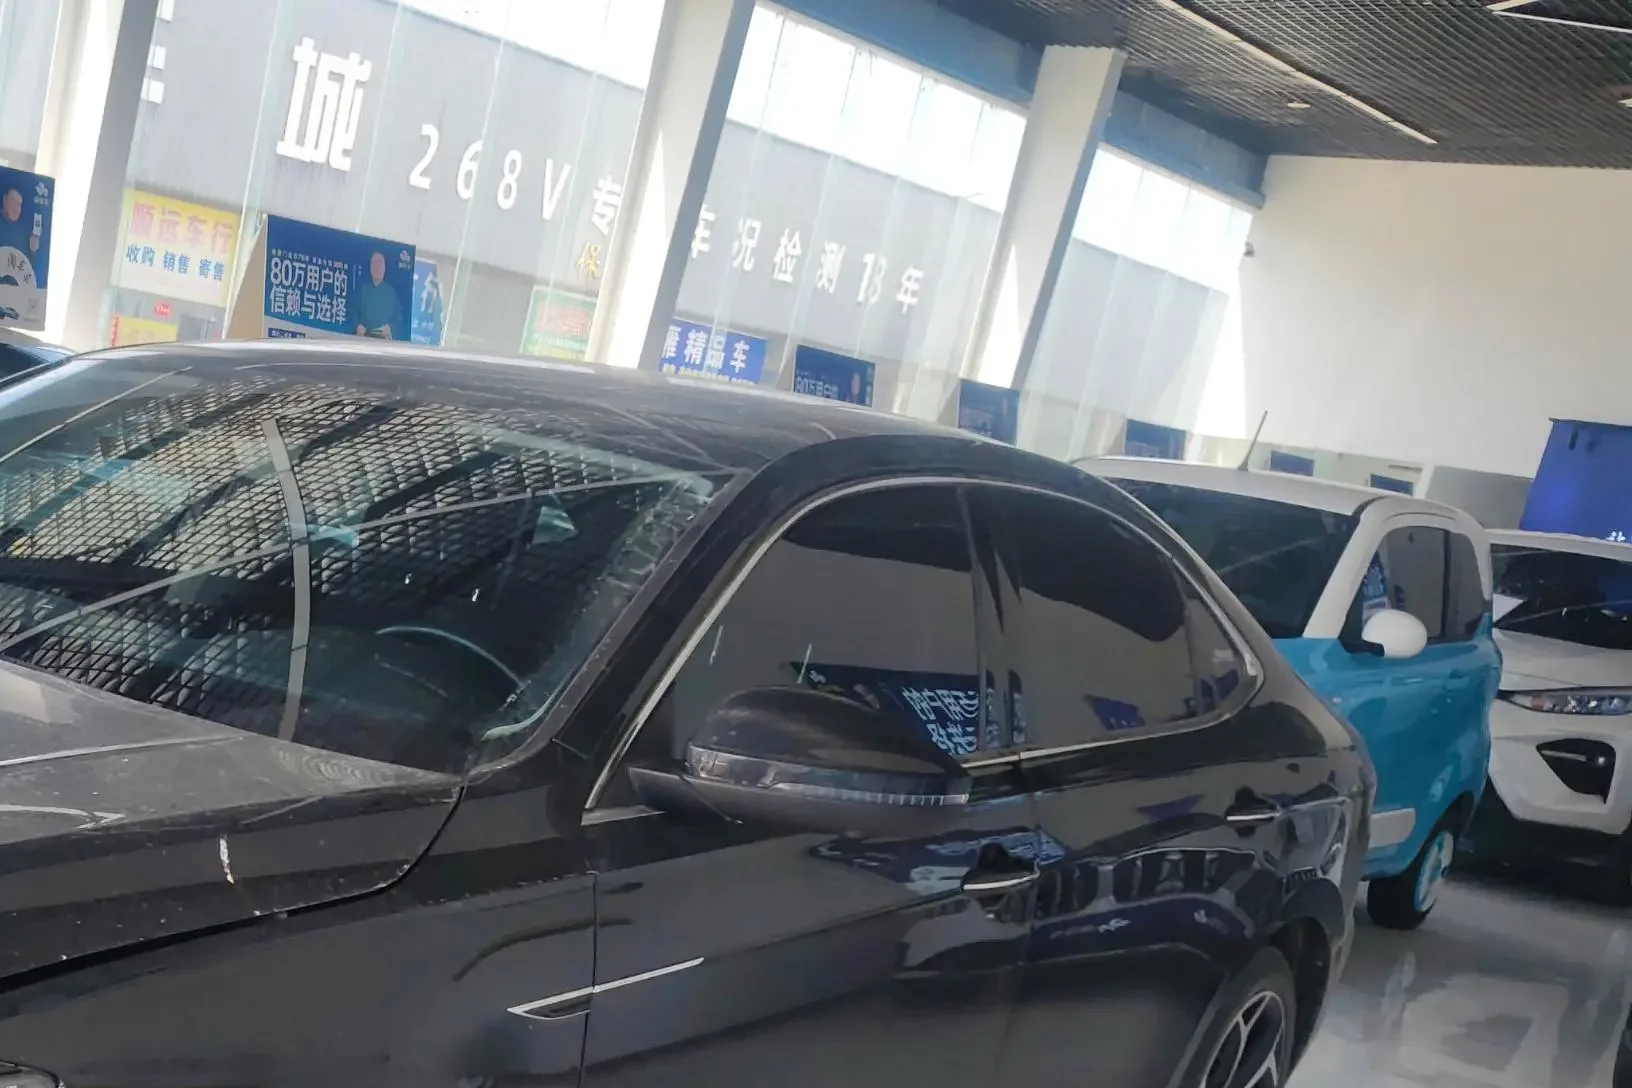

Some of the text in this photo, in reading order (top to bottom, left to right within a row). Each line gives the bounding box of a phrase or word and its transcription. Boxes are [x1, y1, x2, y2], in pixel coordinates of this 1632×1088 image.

[276, 37, 372, 172] 城
[126, 243, 224, 281] 收购 销售 寄售
[270, 257, 348, 296] 80万用户的
[269, 284, 347, 326] 信赖与选择
